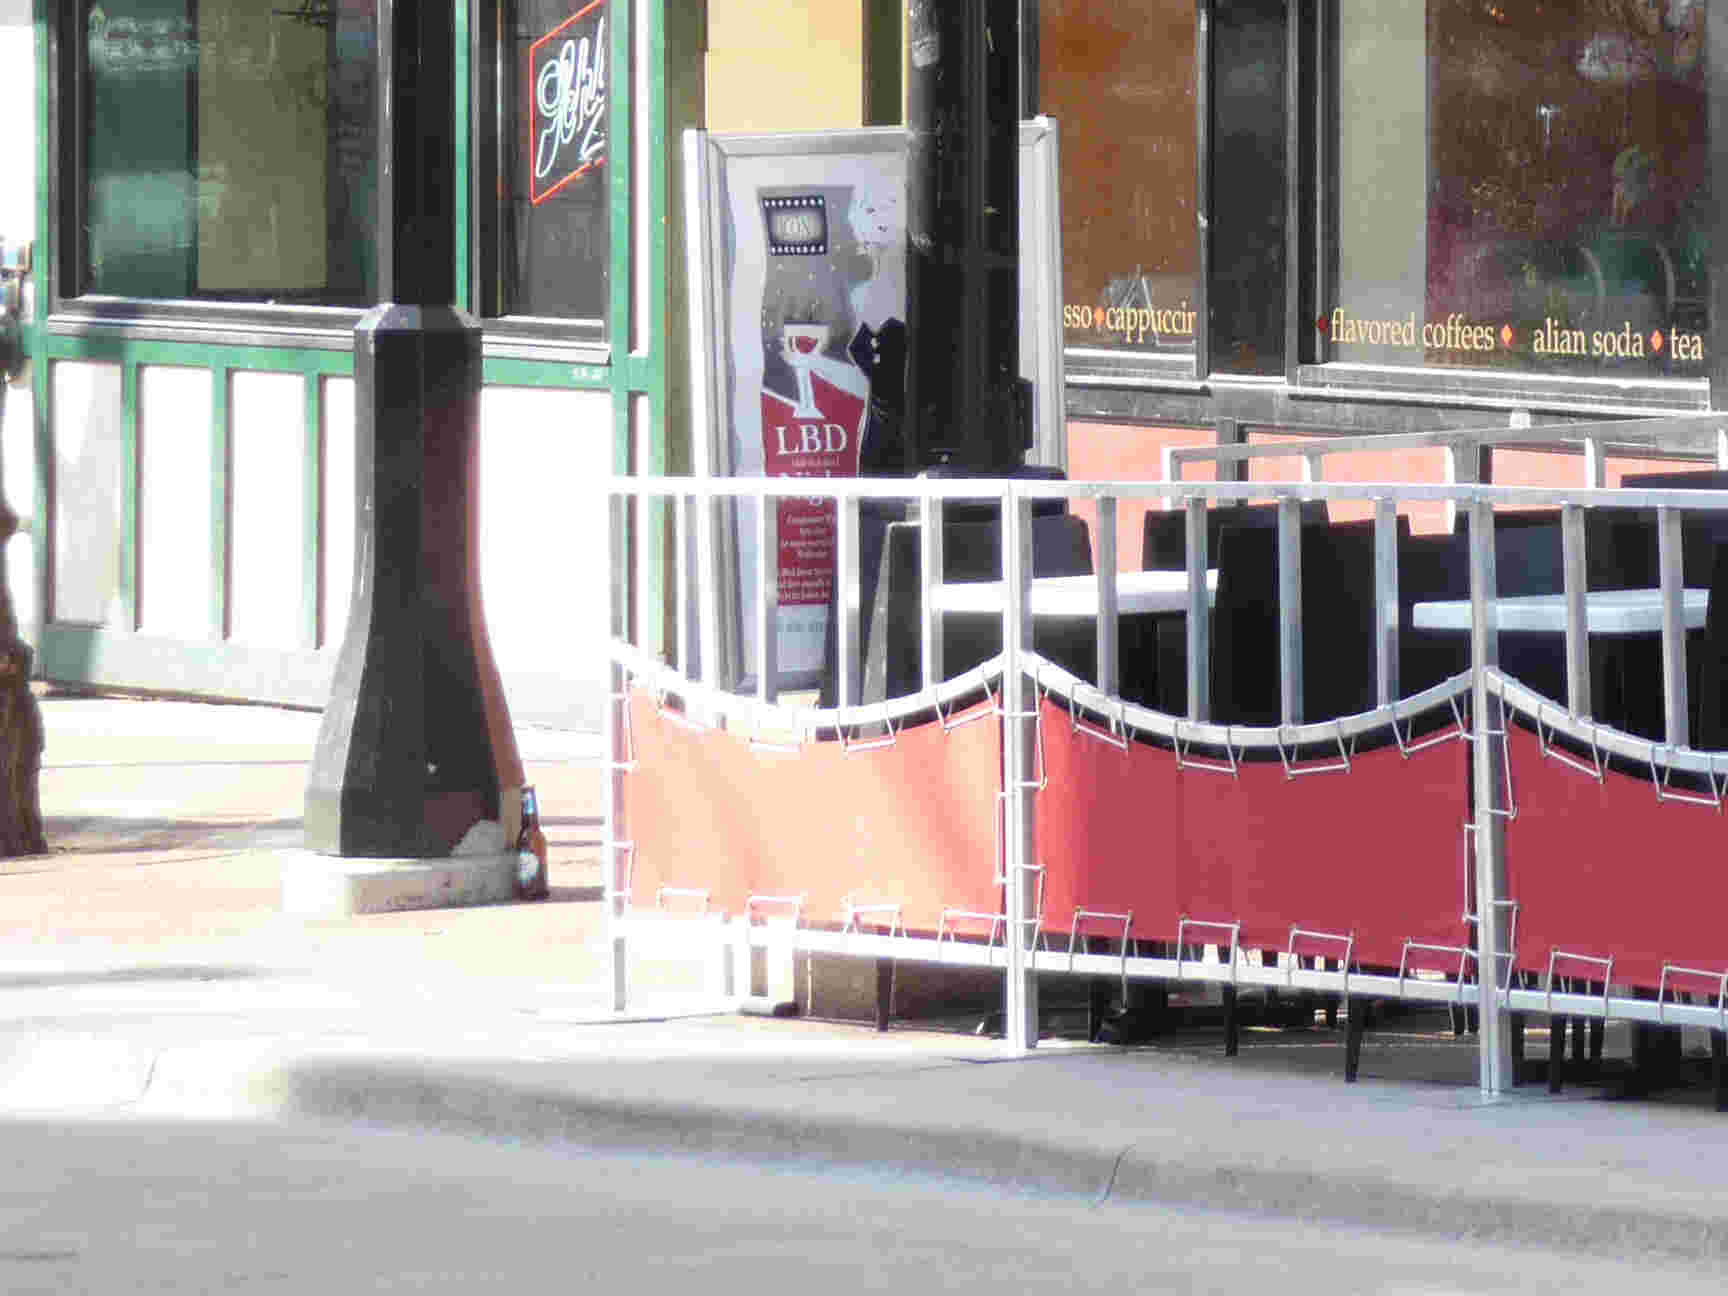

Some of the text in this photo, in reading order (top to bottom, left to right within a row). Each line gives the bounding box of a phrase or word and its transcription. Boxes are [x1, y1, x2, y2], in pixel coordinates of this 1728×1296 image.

[1330, 307, 1416, 345] flavored
[1422, 313, 1495, 352] coffees
[1591, 321, 1645, 357] soda
[1671, 328, 1704, 360] tea
[775, 423, 848, 456] LBD
